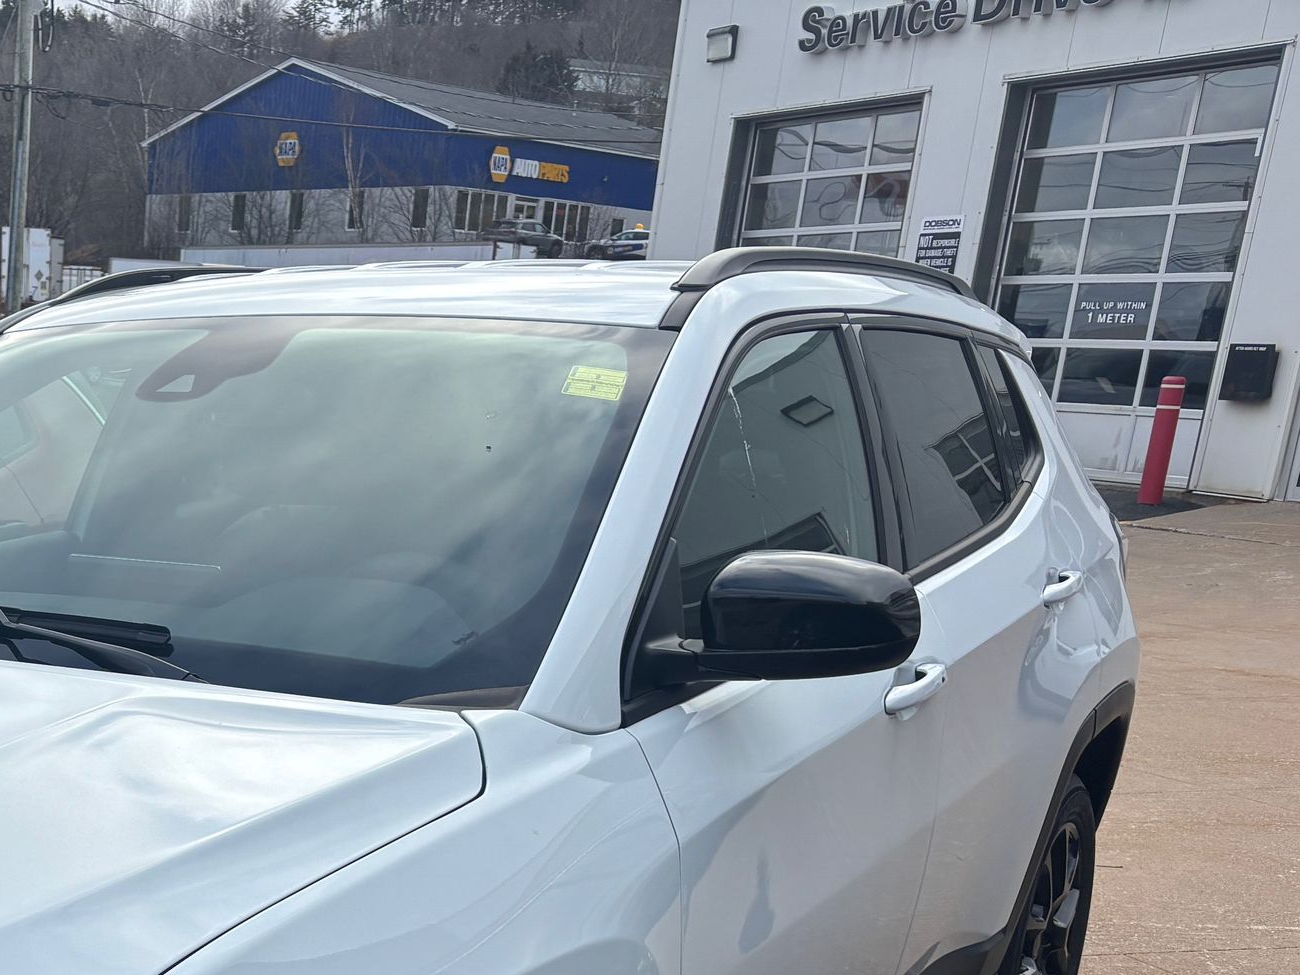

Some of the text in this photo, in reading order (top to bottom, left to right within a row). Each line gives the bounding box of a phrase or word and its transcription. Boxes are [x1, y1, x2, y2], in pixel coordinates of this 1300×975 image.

[798, 0, 962, 52] Service
[491, 154, 510, 173] NAPA
[511, 158, 539, 179] AUTO
[924, 219, 961, 227] DOBSON
[919, 235, 933, 248] NOT
[1080, 301, 1147, 310] PULL UP WITHIN
[1087, 311, 1135, 324] 1 METER
